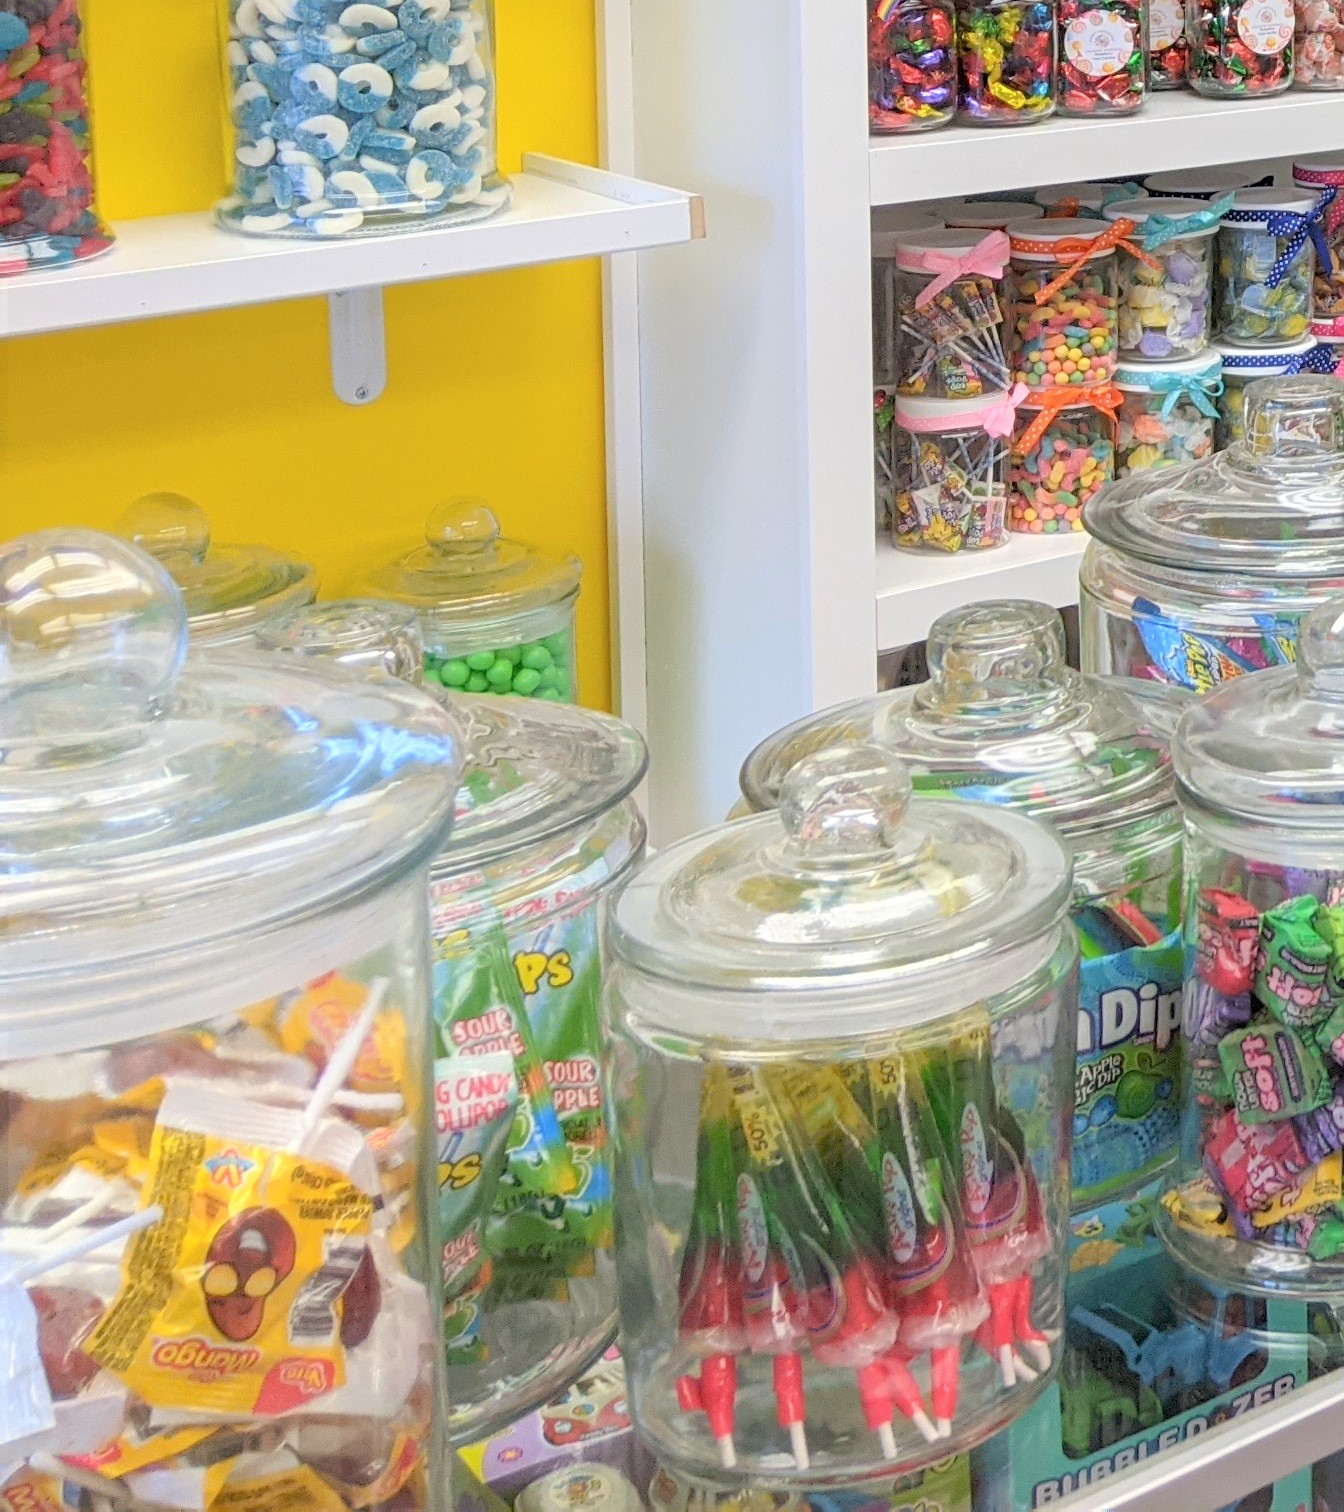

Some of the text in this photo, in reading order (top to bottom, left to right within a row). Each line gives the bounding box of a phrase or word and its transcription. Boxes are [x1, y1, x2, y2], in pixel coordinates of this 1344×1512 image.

[453, 1007, 513, 1045] SOUR
[1101, 982, 1183, 1052] Dip
[455, 1072, 513, 1102] CANDY
[553, 1085, 601, 1113] PPLE
[436, 1098, 510, 1134] OLLIPOP
[157, 1339, 261, 1373] Mango
